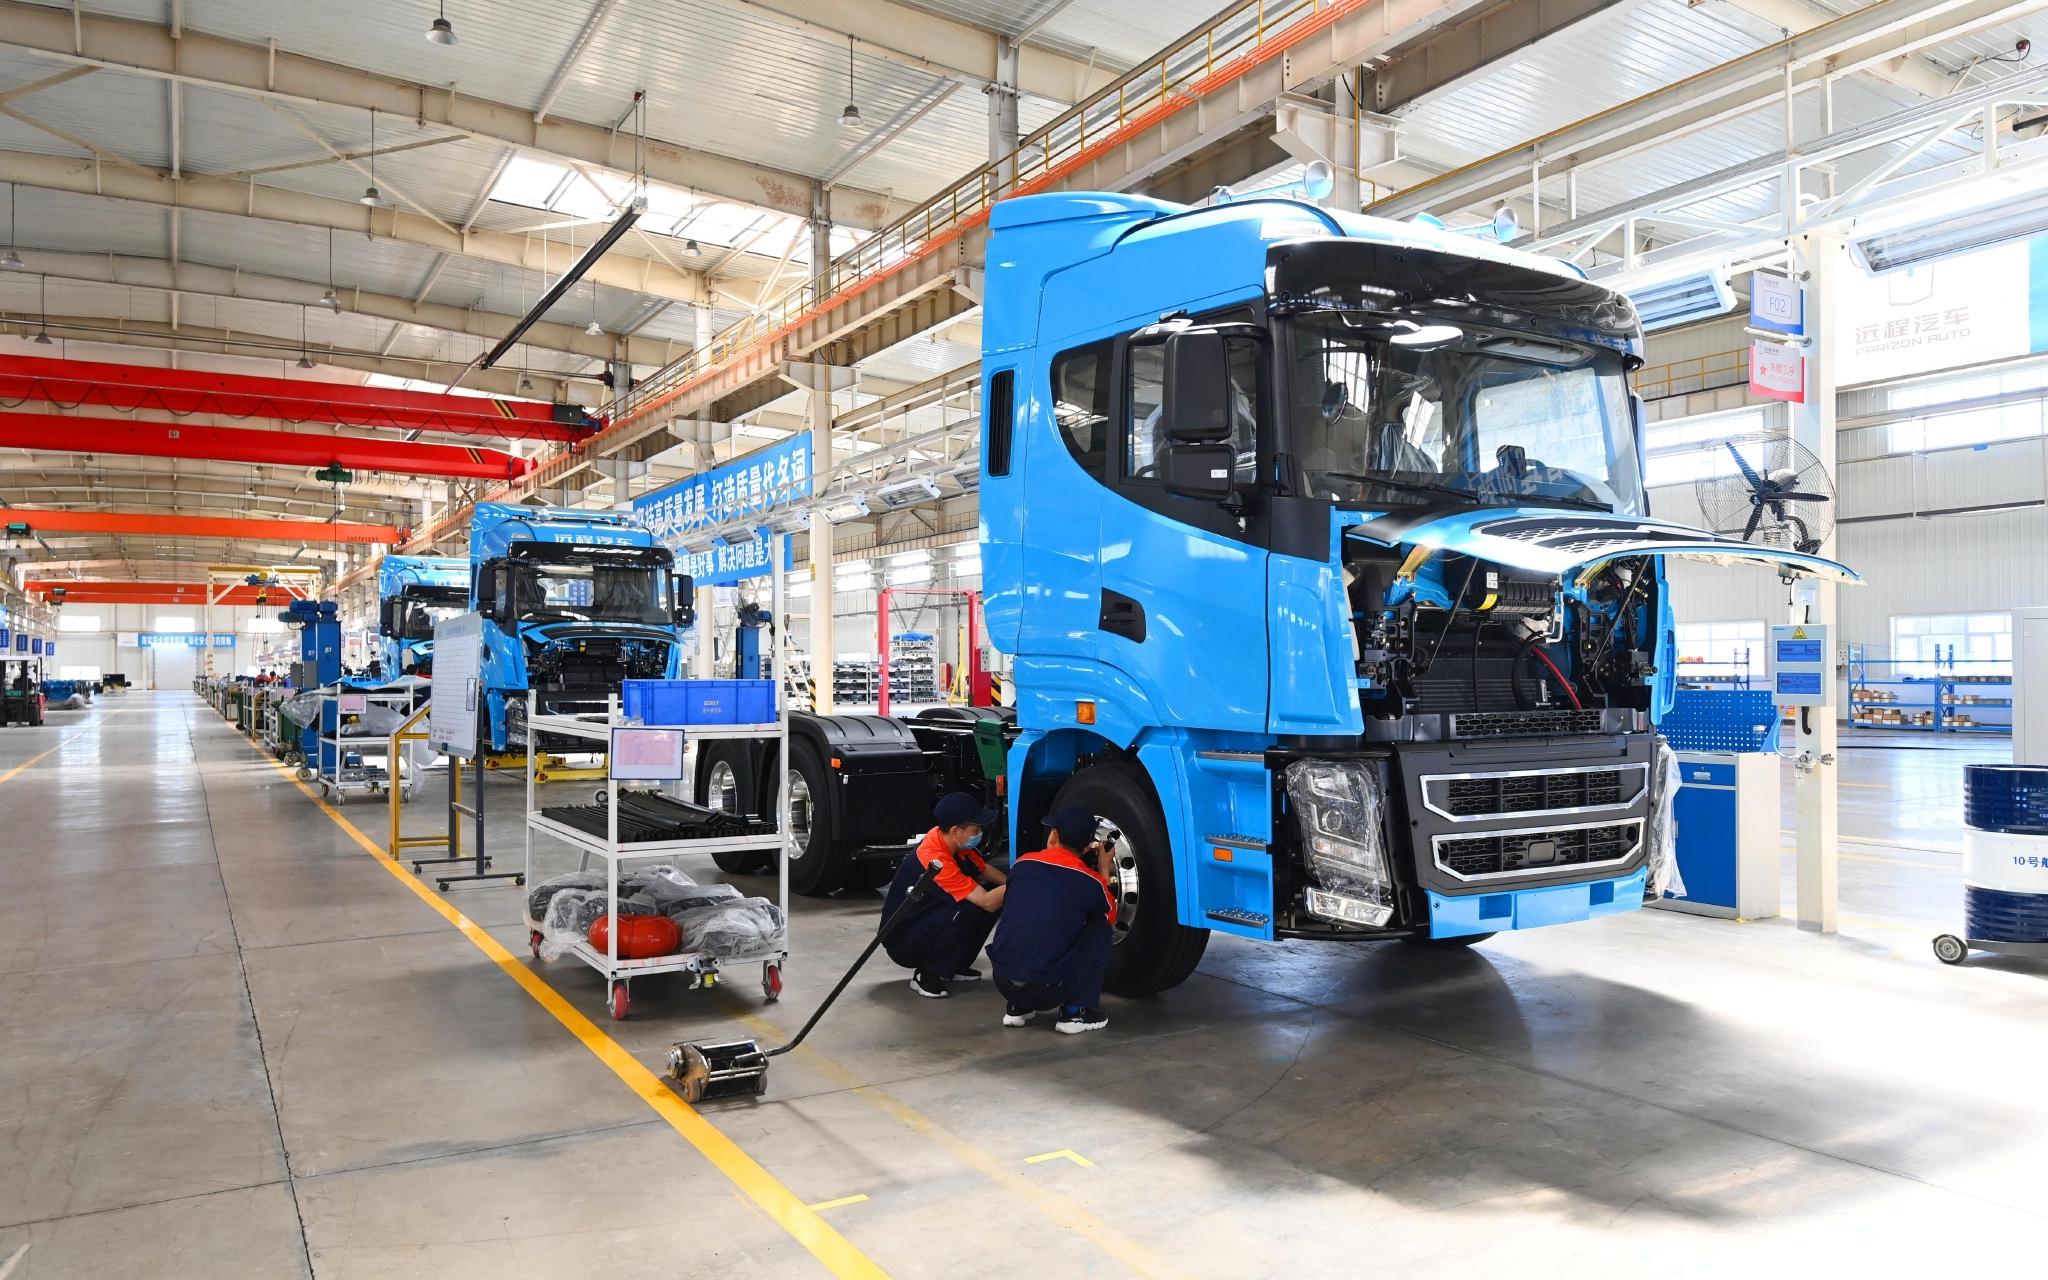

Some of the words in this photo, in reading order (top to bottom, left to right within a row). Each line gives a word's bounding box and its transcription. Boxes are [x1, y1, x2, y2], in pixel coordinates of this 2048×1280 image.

[1769, 296, 1786, 313] F02
[1855, 306, 1970, 345] 远程汽车
[1855, 337, 1922, 356] FARIZON
[1927, 328, 1971, 343] AUTO
[711, 447, 806, 517] 打造质量代名词
[673, 550, 715, 579] 问题是好事
[718, 533, 785, 574] 解决问题是大
